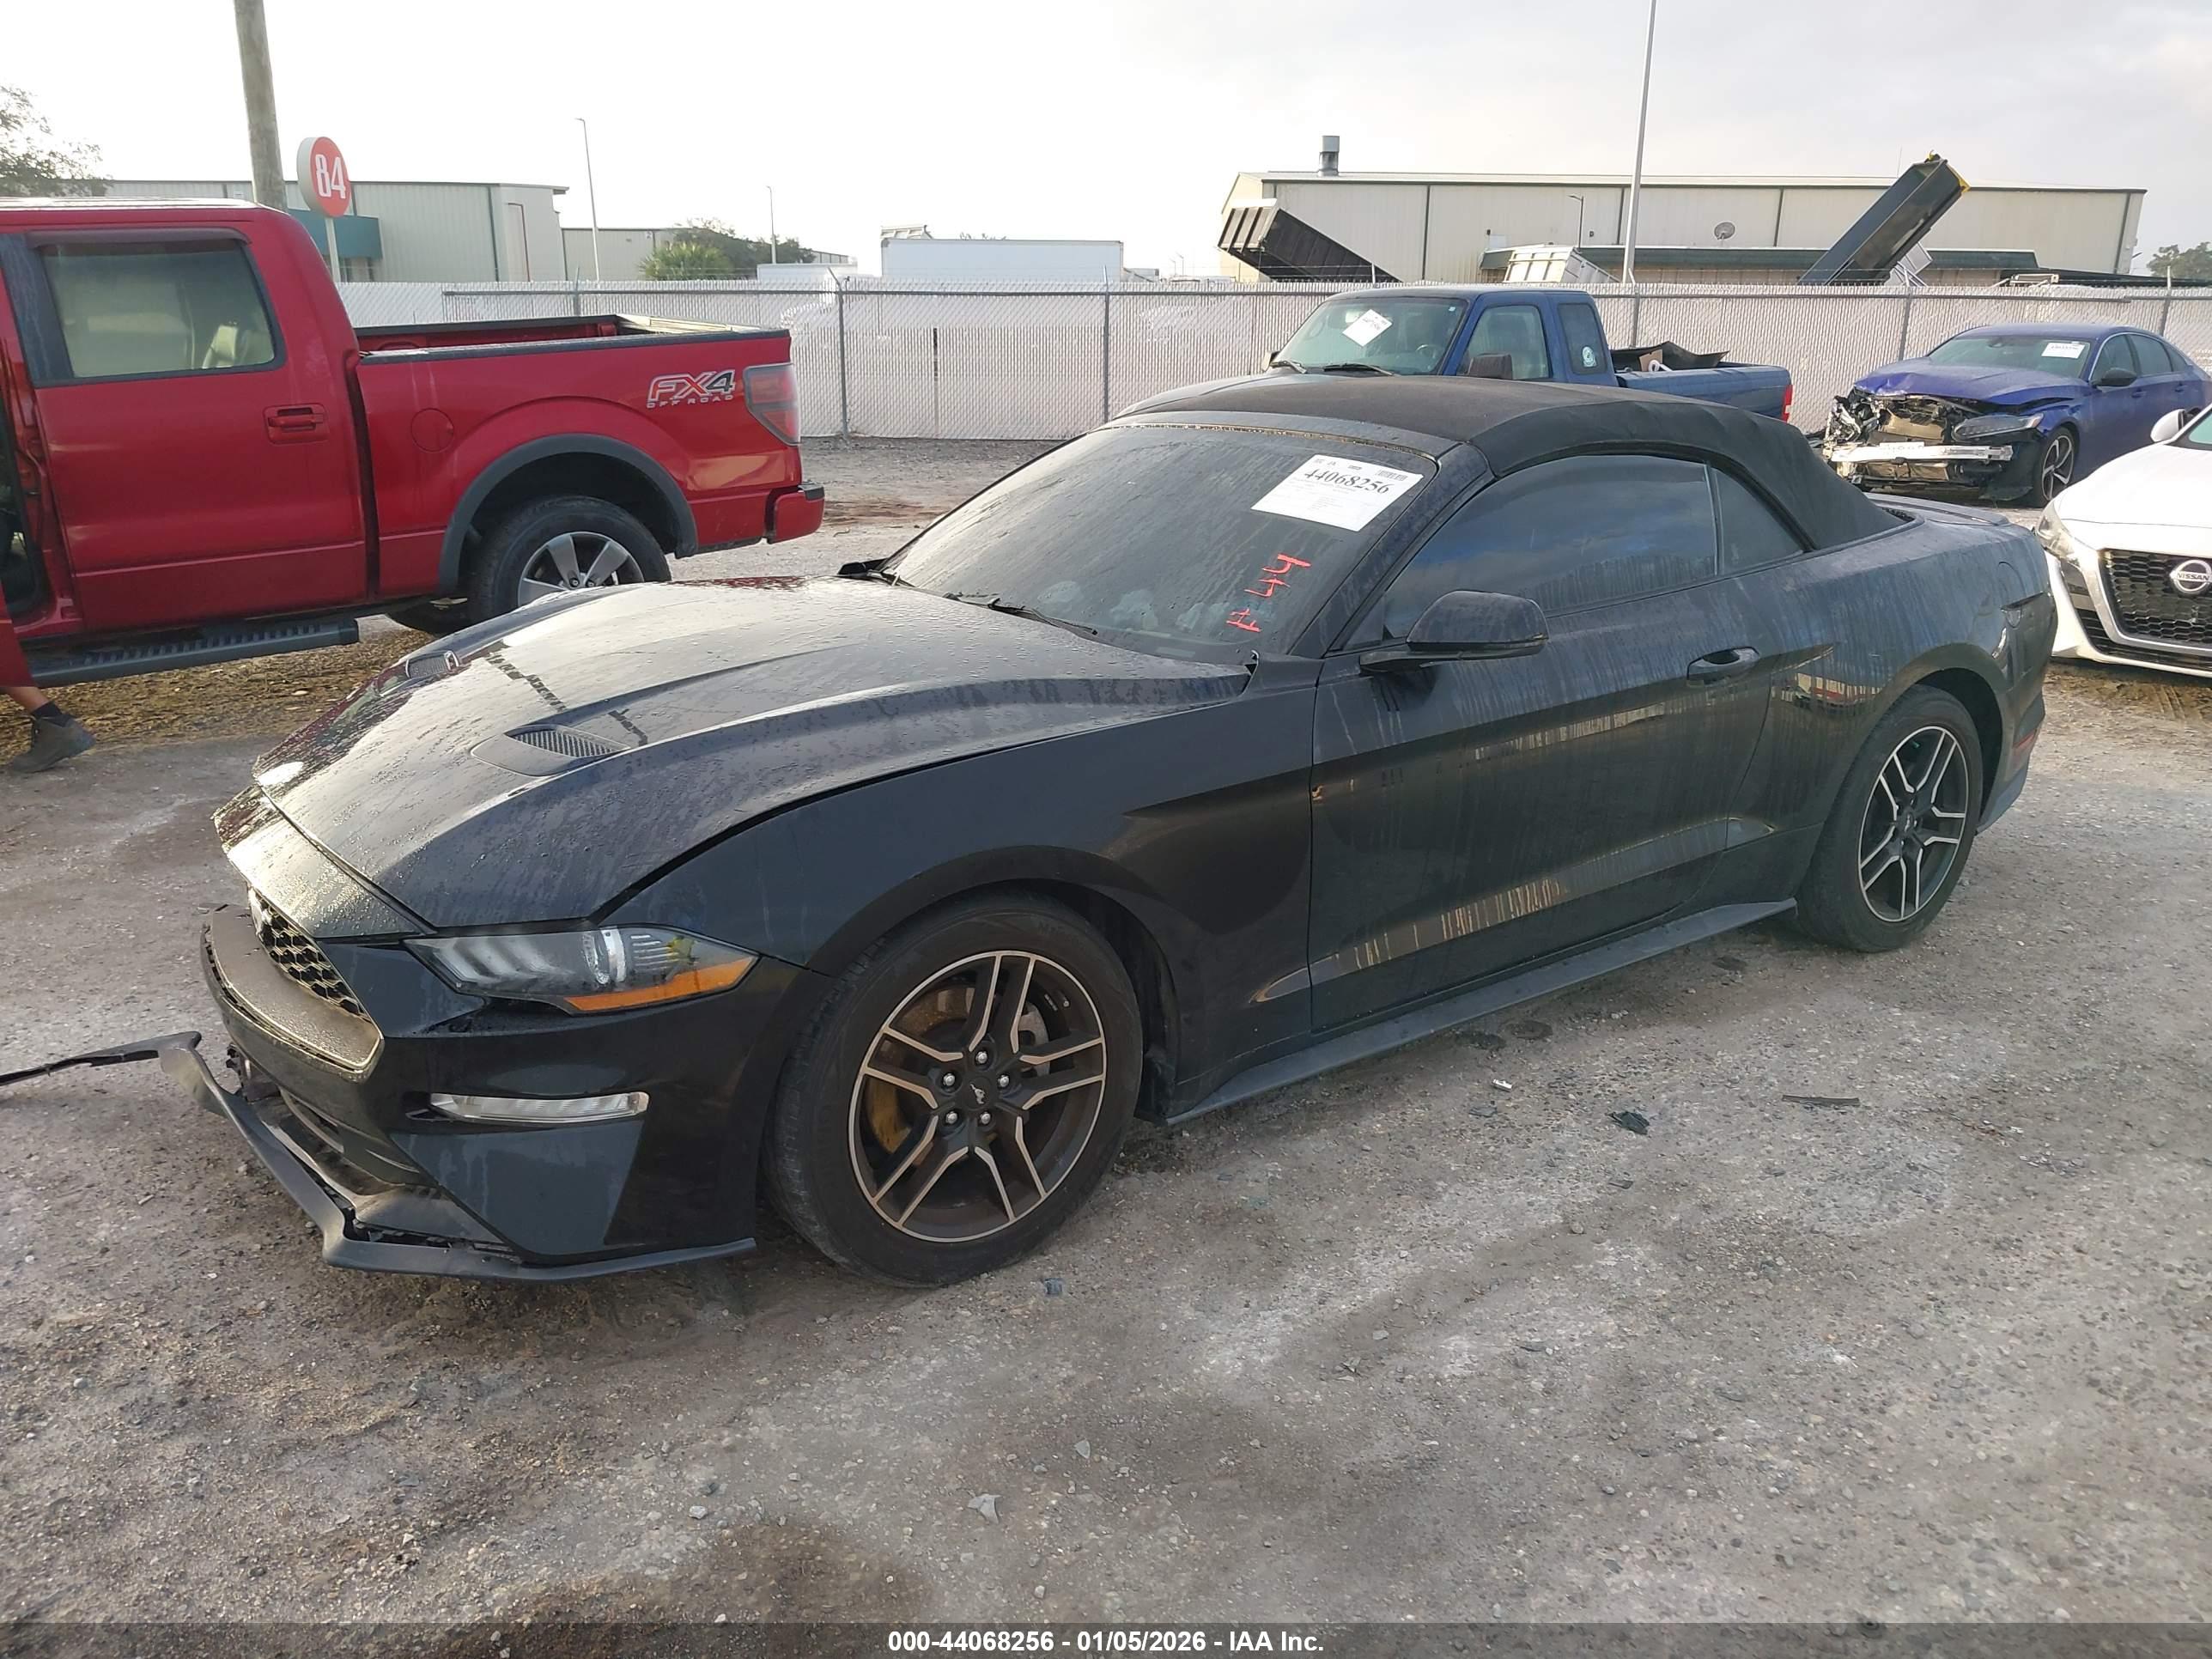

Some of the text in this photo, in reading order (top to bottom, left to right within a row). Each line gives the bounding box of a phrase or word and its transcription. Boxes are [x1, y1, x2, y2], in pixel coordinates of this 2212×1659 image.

[315, 154, 346, 199] 84
[647, 369, 736, 403] FX4
[647, 394, 734, 409] OFF ROAD
[1304, 469, 1395, 495] 44068256
[2177, 572, 2210, 581] NISSAN
